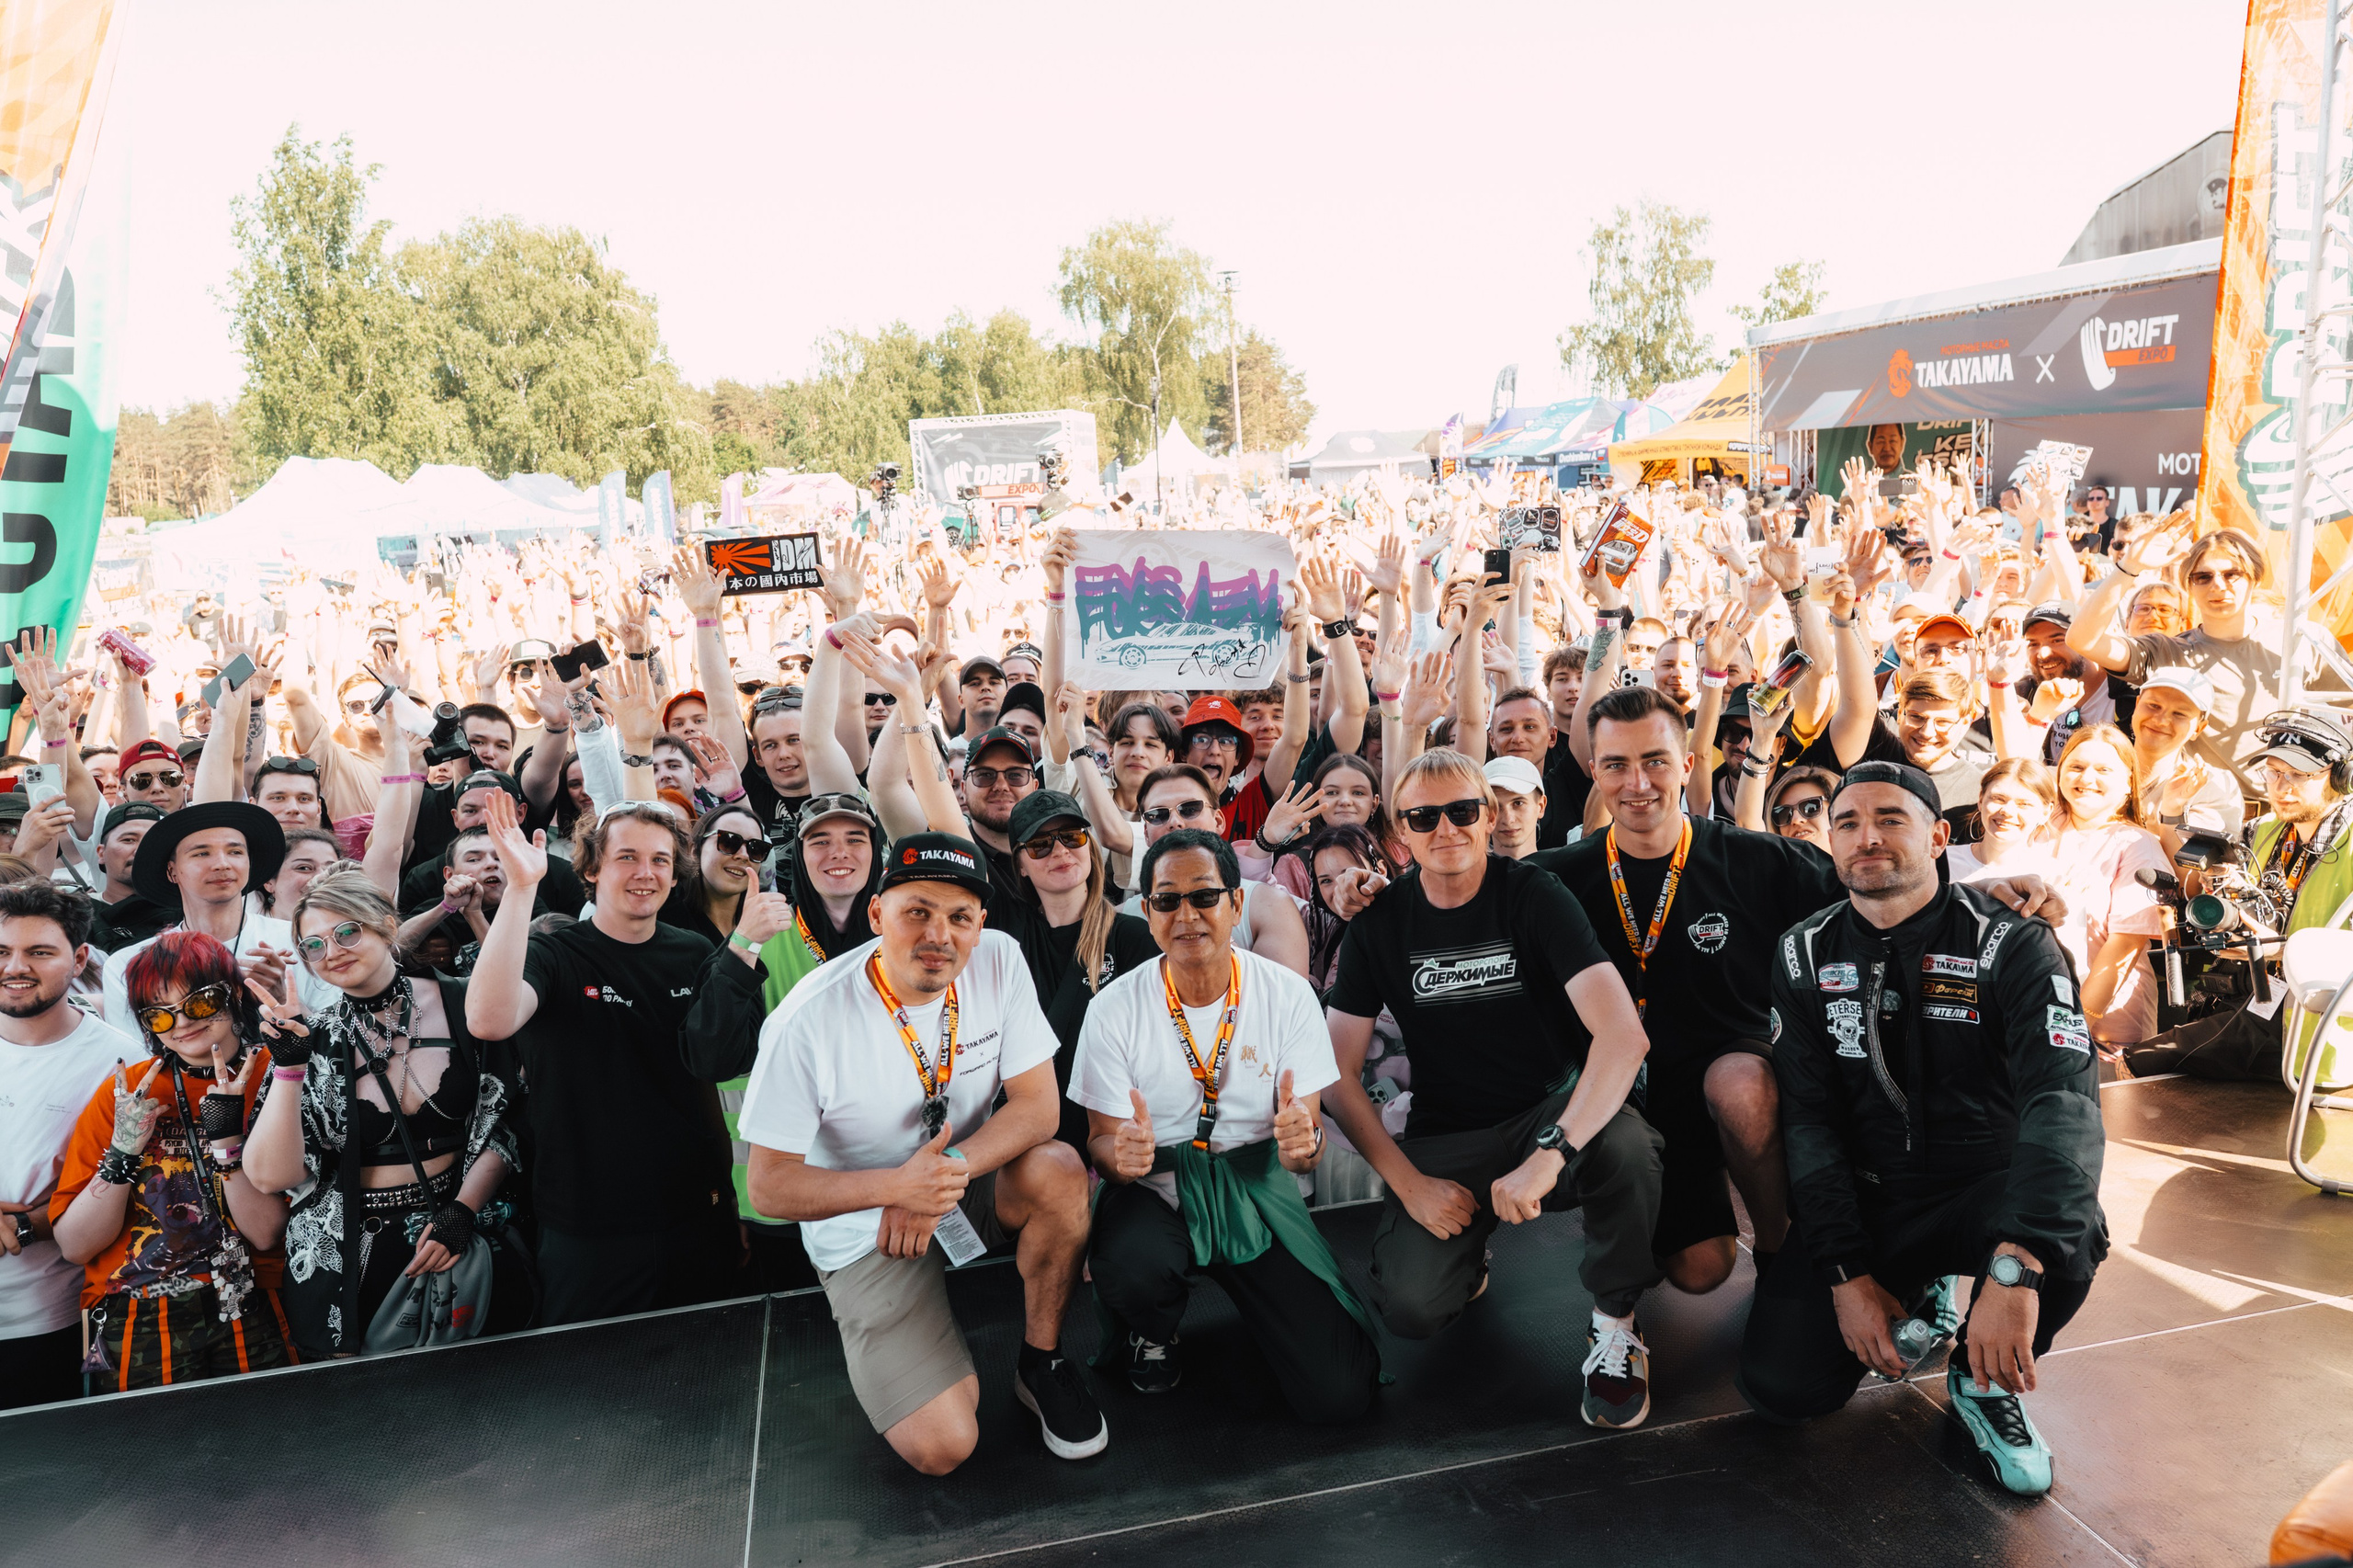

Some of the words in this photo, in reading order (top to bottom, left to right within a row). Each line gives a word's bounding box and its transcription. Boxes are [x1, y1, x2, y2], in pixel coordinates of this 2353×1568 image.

[2107, 314, 2178, 352] DRIFT
[1940, 341, 1978, 356] МОТОРНЫЕ
[1979, 338, 2010, 351] МАСЛА
[2138, 346, 2169, 362] EXPO
[1915, 353, 2015, 388] TAKAYAMA
[972, 461, 1040, 486] DRIFT
[772, 537, 817, 572] JDM
[920, 849, 975, 869] TAKAYAMA
[1661, 878, 1672, 895] NEED
[1667, 866, 1682, 896] DRIFT
[1658, 895, 1667, 908] WE
[1625, 907, 1635, 920] WE
[1654, 910, 1663, 923] ALL
[1623, 923, 1640, 952] DRIFT
[1699, 926, 1723, 934] DRIFT
[805, 935, 825, 959] DRIFT
[1979, 921, 2011, 970] sparco
[1456, 955, 1509, 970] МОТОРСПОРТ
[1784, 935, 1802, 981] sparco
[1414, 962, 1517, 994] СДЕРЖИМЫЕ
[949, 1000, 959, 1034] DRIFT
[1828, 1003, 1861, 1016] ETERSE
[1922, 1006, 1968, 1019] ЗРИТЕЛИ
[942, 1017, 950, 1034] NEED
[1173, 1008, 1193, 1039] DRIFT
[965, 1031, 999, 1051] TAKAYAMA
[1175, 1025, 1187, 1041] NEED
[942, 1034, 950, 1050] WE
[1181, 1040, 1193, 1056] WE
[1219, 1039, 1229, 1054] ALL
[911, 1040, 925, 1056] ALL
[920, 1055, 930, 1069] WE
[940, 1050, 950, 1066] ALL
[1188, 1054, 1200, 1069] ALL
[1215, 1054, 1225, 1070] WE
[960, 1062, 986, 1076] FORWARD
[1213, 1070, 1222, 1084] NEED
[1205, 1068, 1215, 1093] DRIFT
[171, 1127, 208, 1137] DAGE
